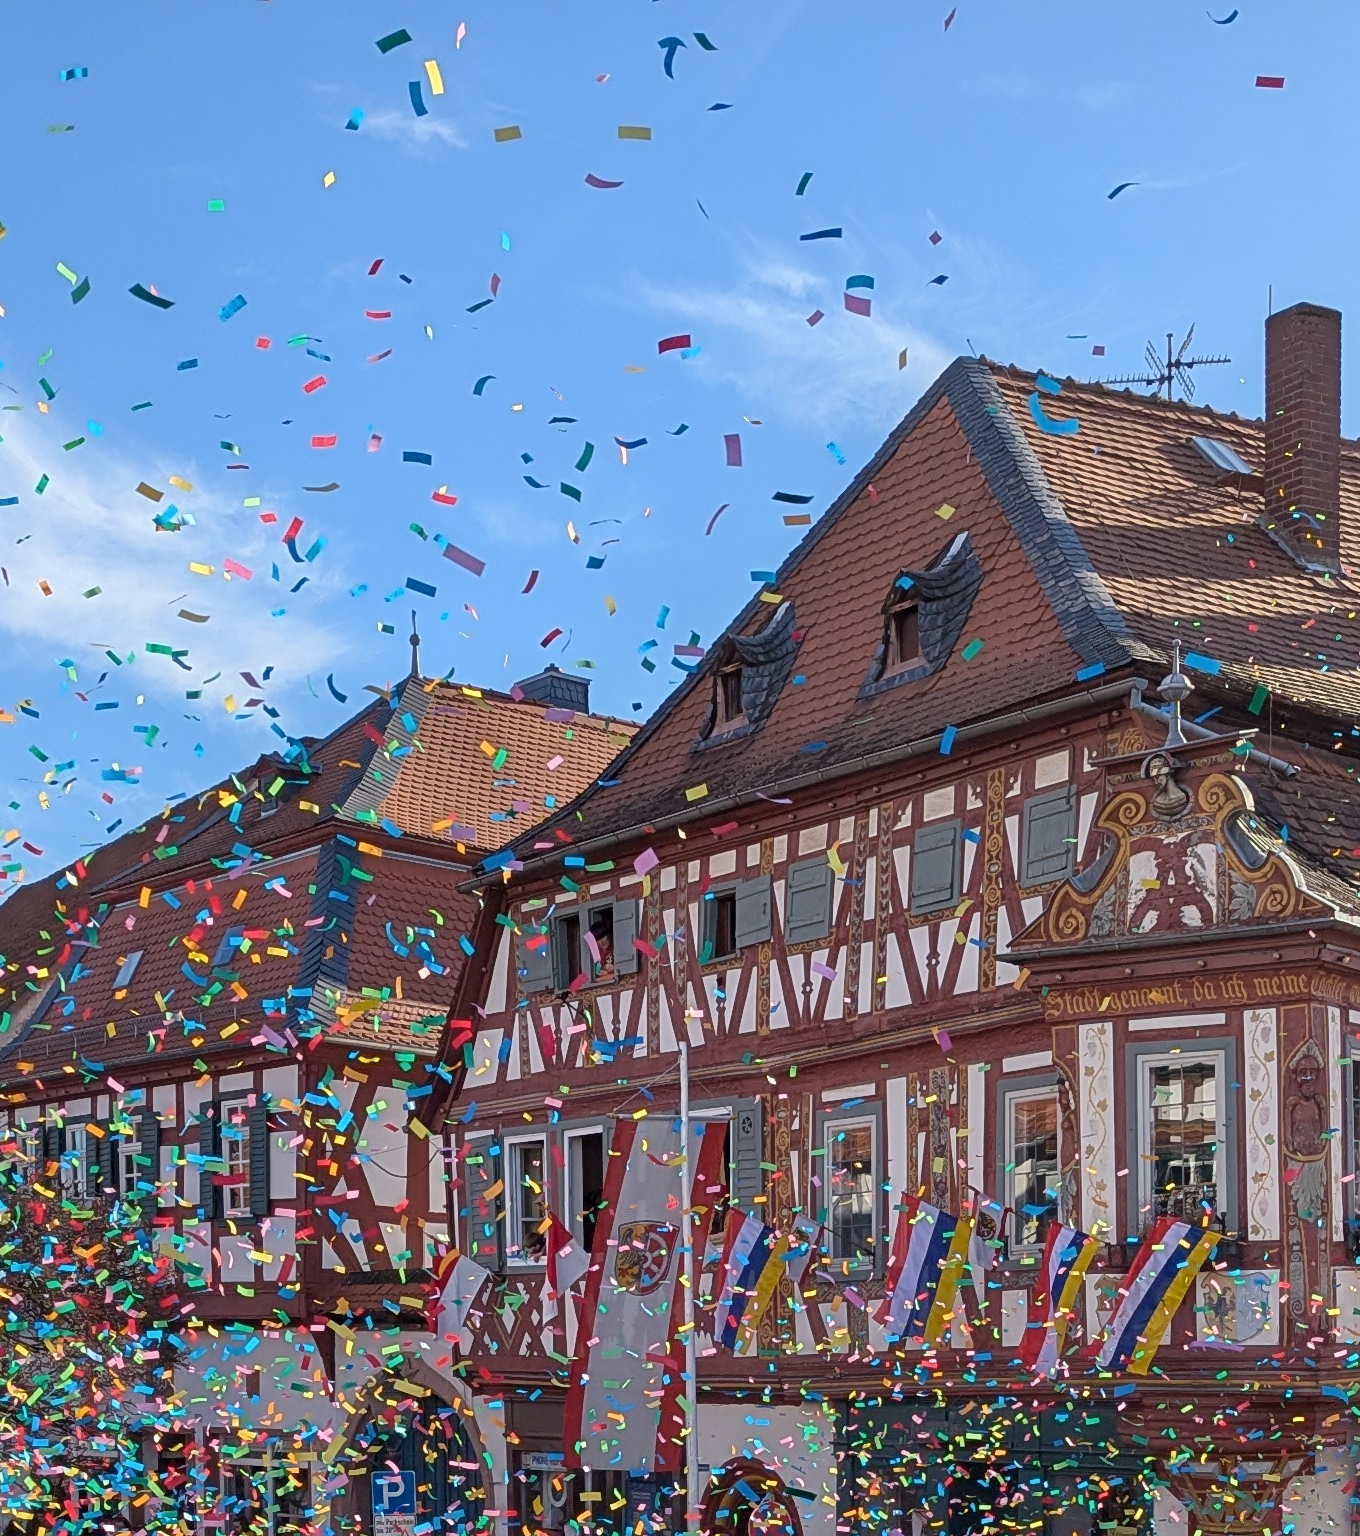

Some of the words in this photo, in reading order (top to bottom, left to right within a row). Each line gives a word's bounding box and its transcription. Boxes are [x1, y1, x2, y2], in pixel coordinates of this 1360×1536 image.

[1044, 986, 1102, 1018] Stadt
[1189, 975, 1217, 1001] da
[1219, 972, 1248, 1003] ich
[1254, 970, 1310, 997] meine
